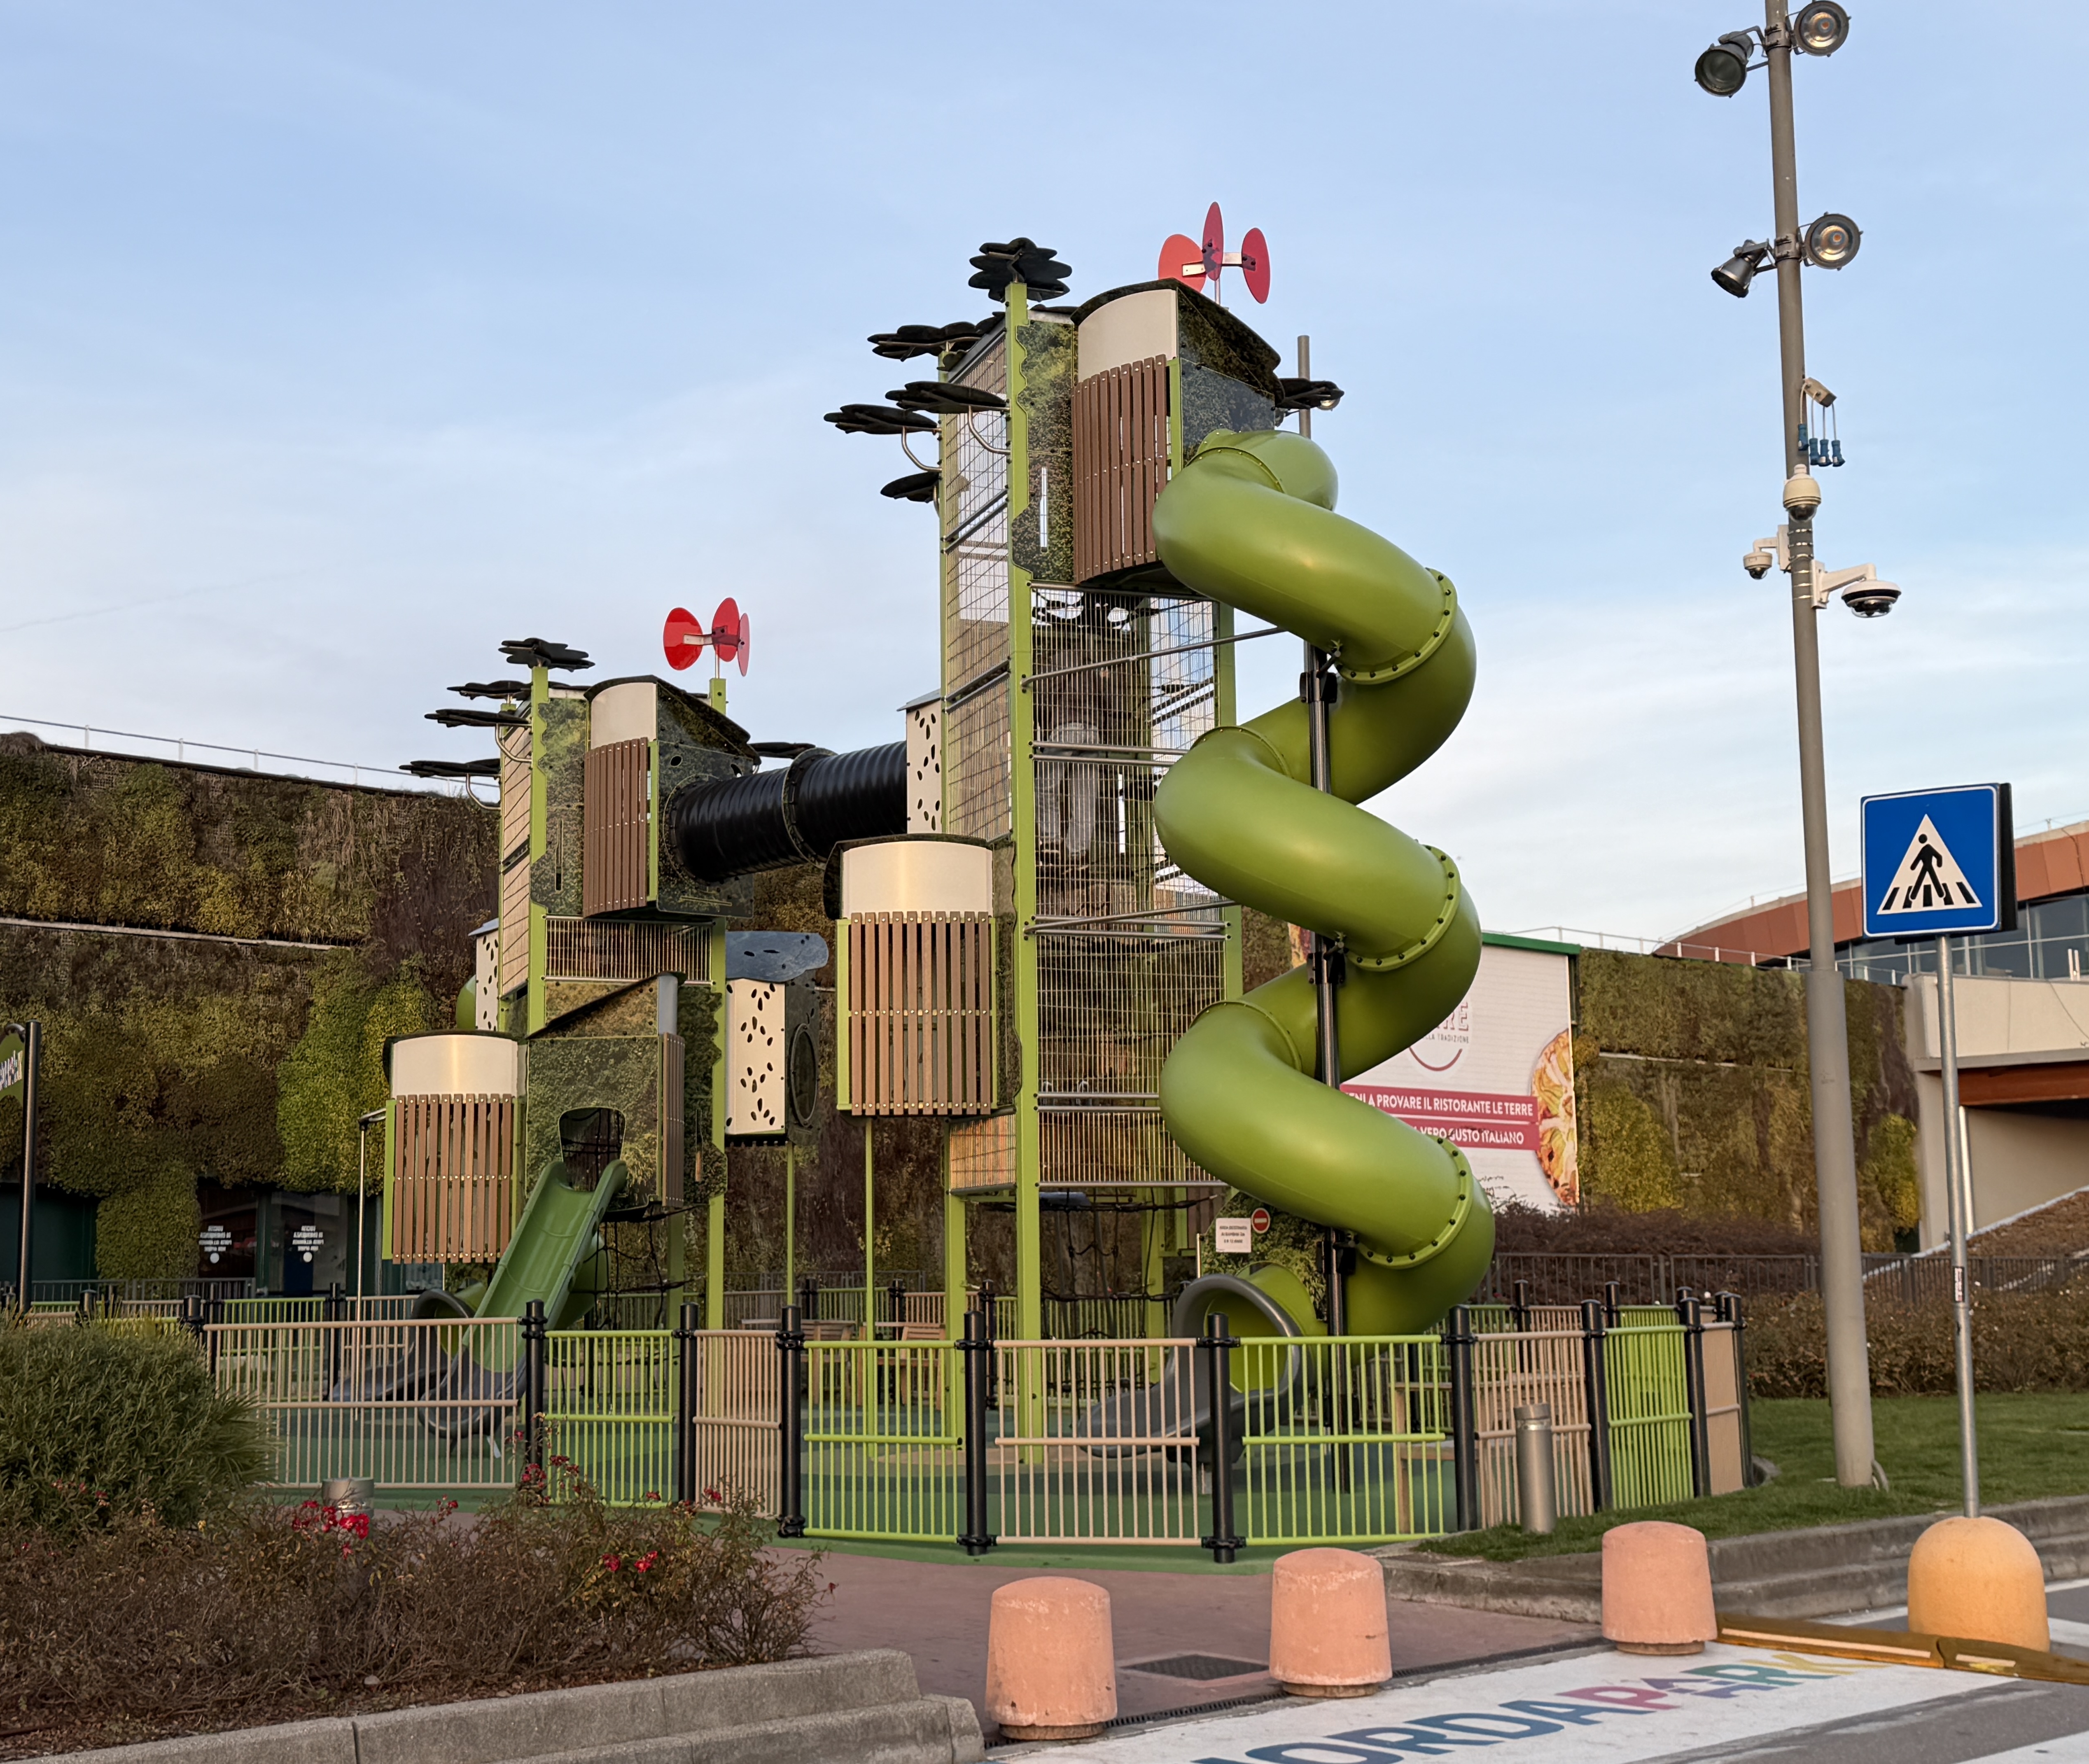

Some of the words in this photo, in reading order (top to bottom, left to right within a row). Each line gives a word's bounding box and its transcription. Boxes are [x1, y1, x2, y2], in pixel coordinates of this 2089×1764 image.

[1437, 1032, 1468, 1044] TRADIZIONE
[1368, 1094, 1376, 1107] A
[1377, 1094, 1422, 1109] PROVARE
[1424, 1097, 1432, 1110] IL
[1433, 1098, 1491, 1114] RISTORANTE
[1493, 1101, 1503, 1114] LE
[1504, 1102, 1533, 1116] TERRE
[1448, 1128, 1480, 1142] GUSTO
[1482, 1130, 1524, 1144] ITALIANO
[1190, 1654, 1893, 1764] ORDAPARK
